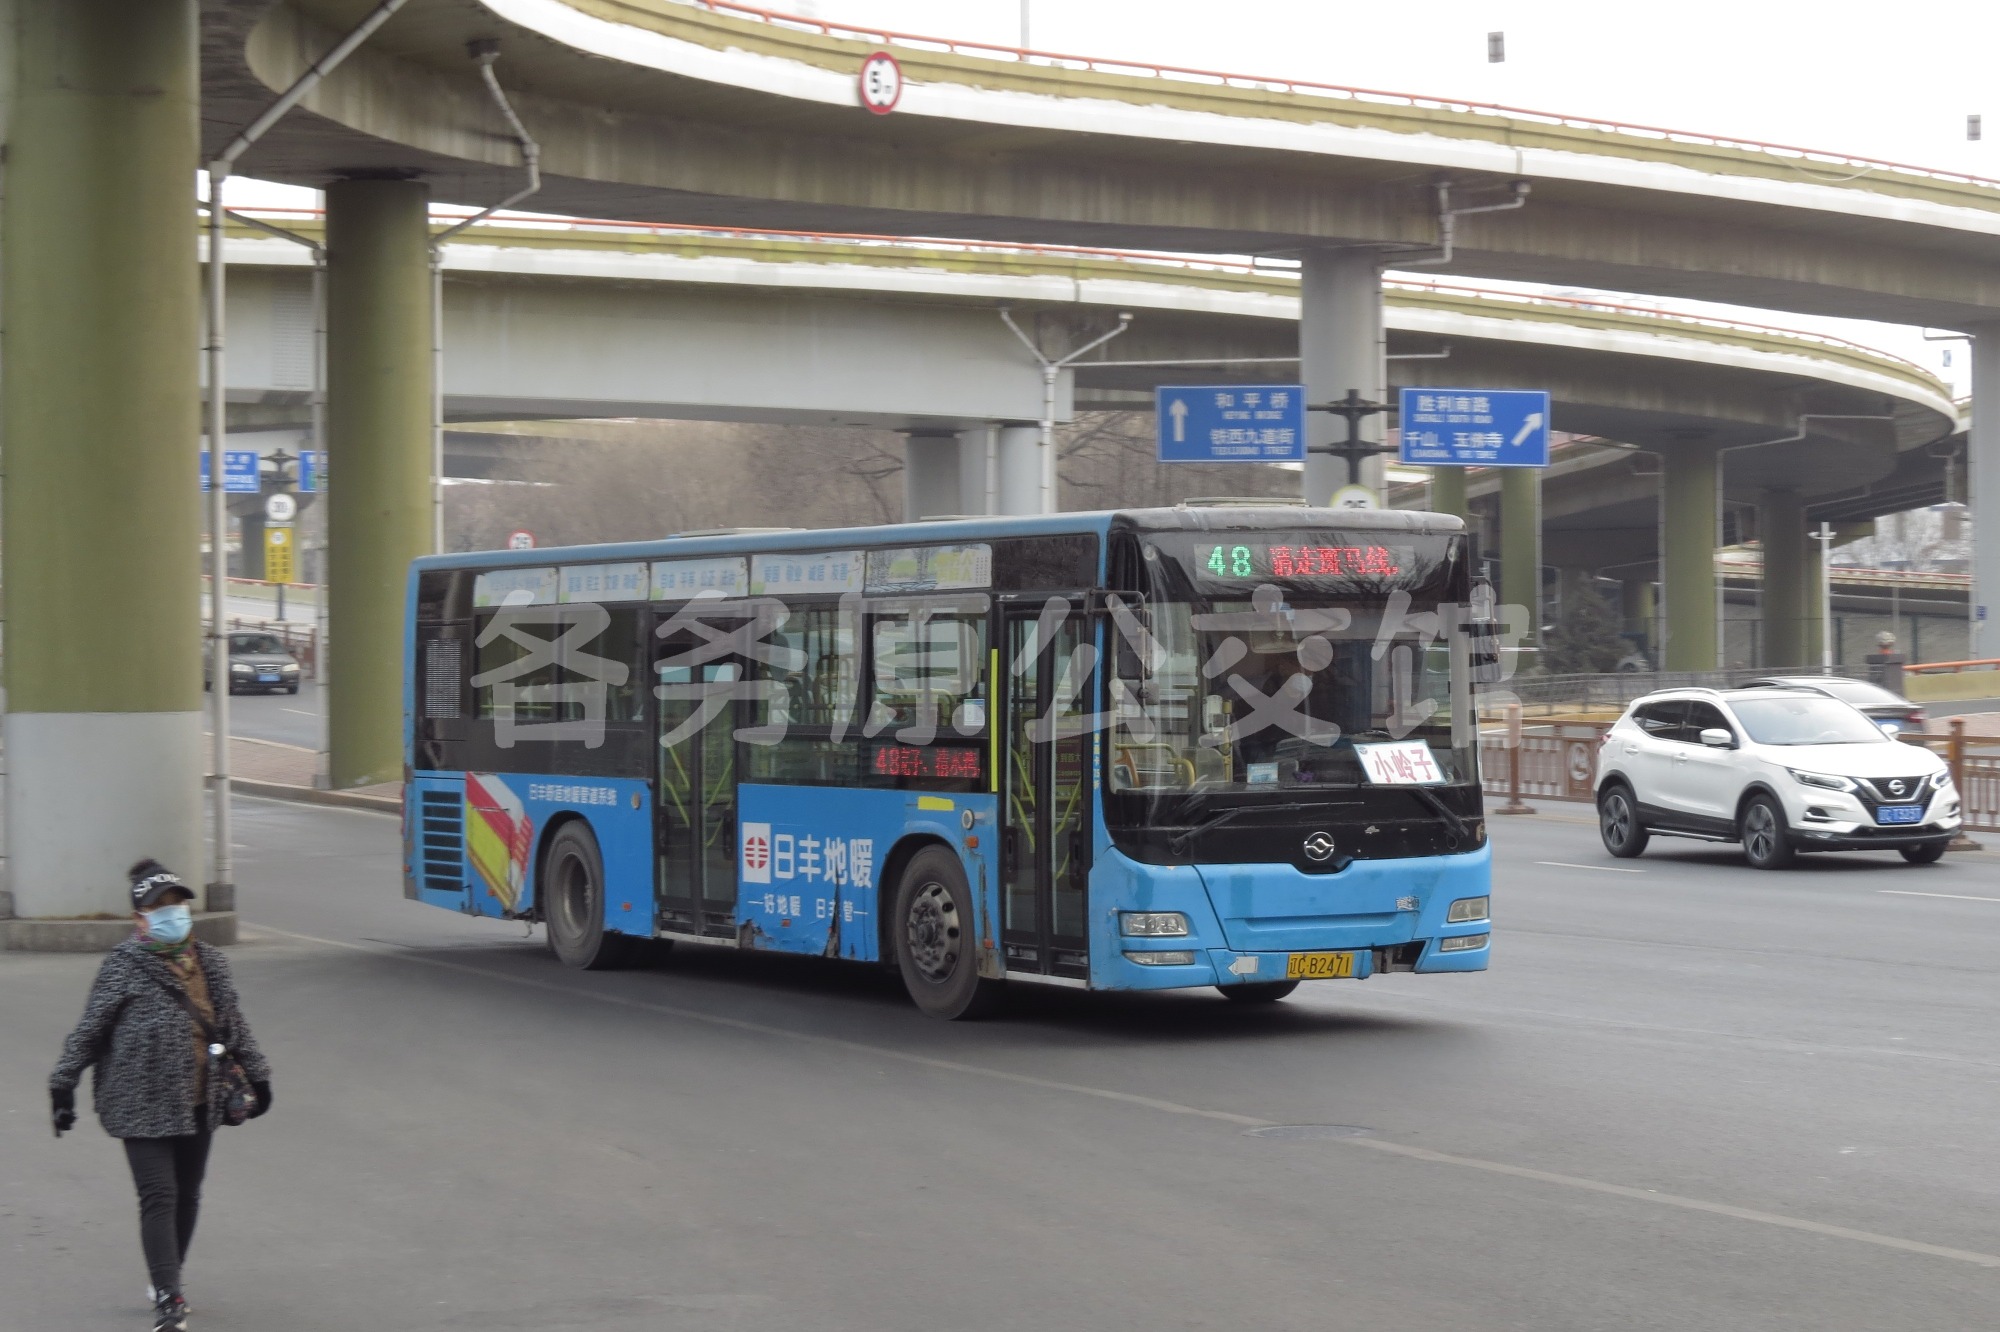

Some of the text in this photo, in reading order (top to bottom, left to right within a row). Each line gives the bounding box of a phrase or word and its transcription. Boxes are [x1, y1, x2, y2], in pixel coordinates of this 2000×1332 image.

[1215, 392, 1289, 408] 和平桥
[1416, 395, 1490, 412] 胜利南路
[1208, 546, 1251, 576] 48
[1374, 749, 1432, 783] 小岭子
[774, 833, 873, 888] 日丰地暖
